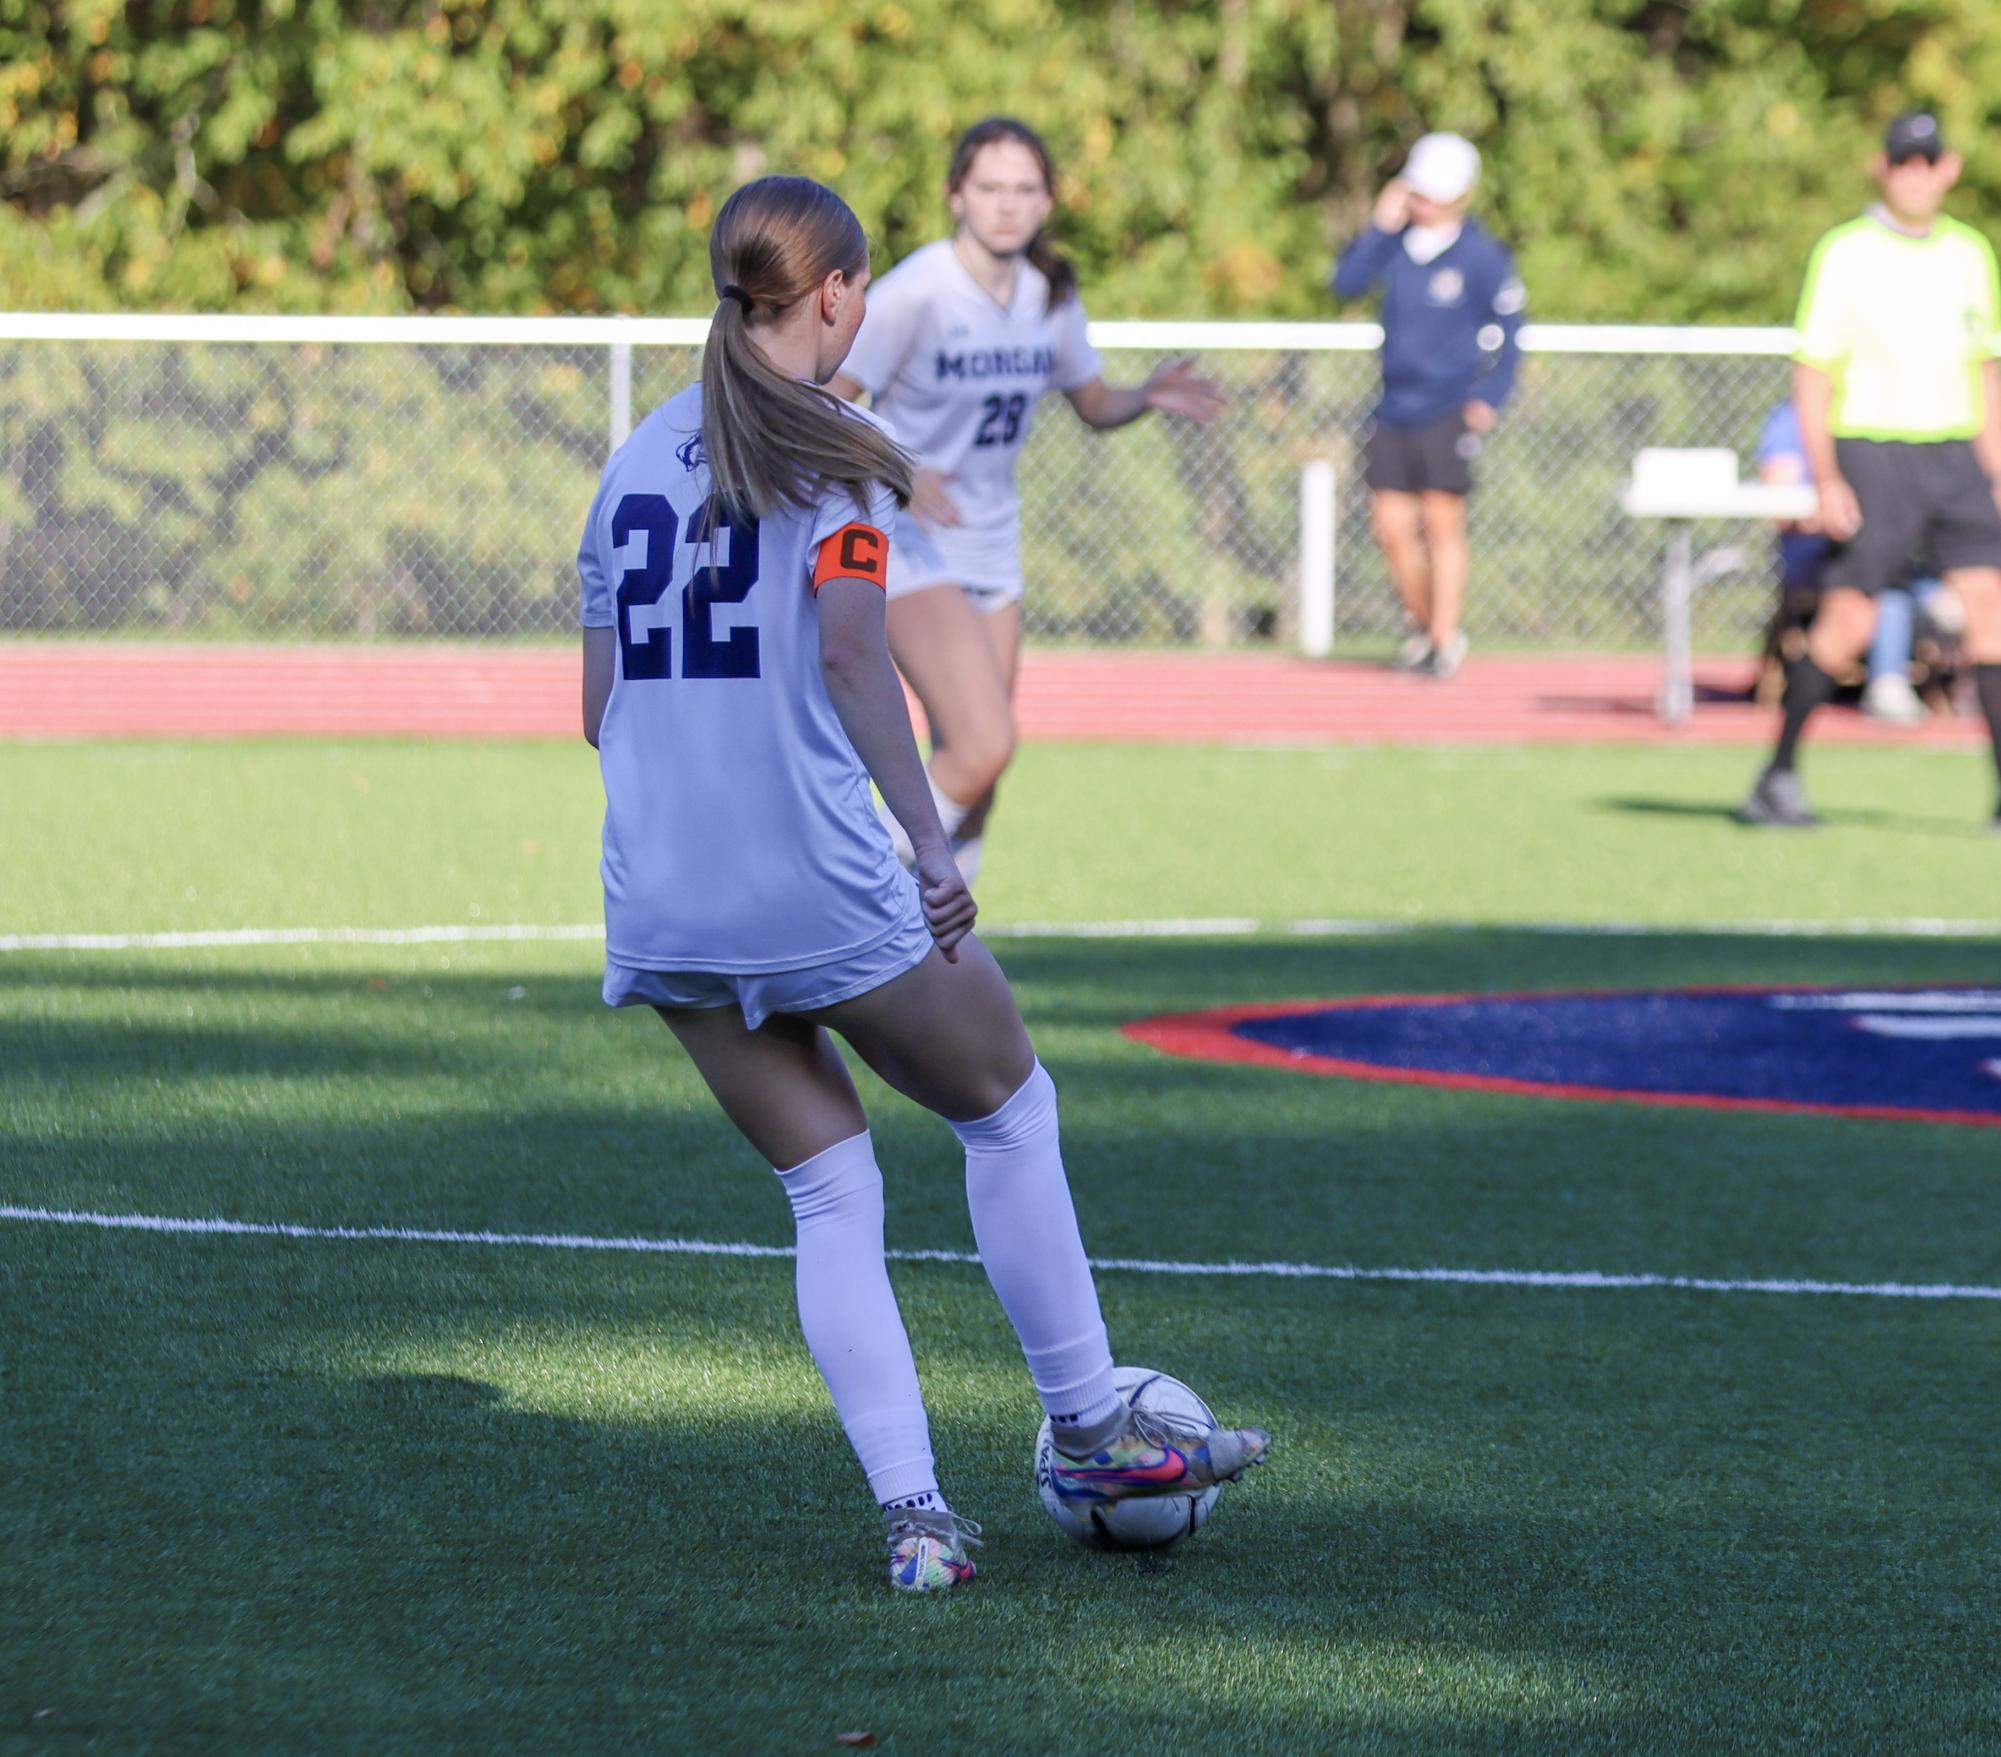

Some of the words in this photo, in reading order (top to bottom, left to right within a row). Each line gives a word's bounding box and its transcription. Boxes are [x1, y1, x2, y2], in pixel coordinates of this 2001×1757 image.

[840, 528, 878, 573] C
[611, 492, 760, 681] 22
[1040, 1439, 1052, 1489] SPA
